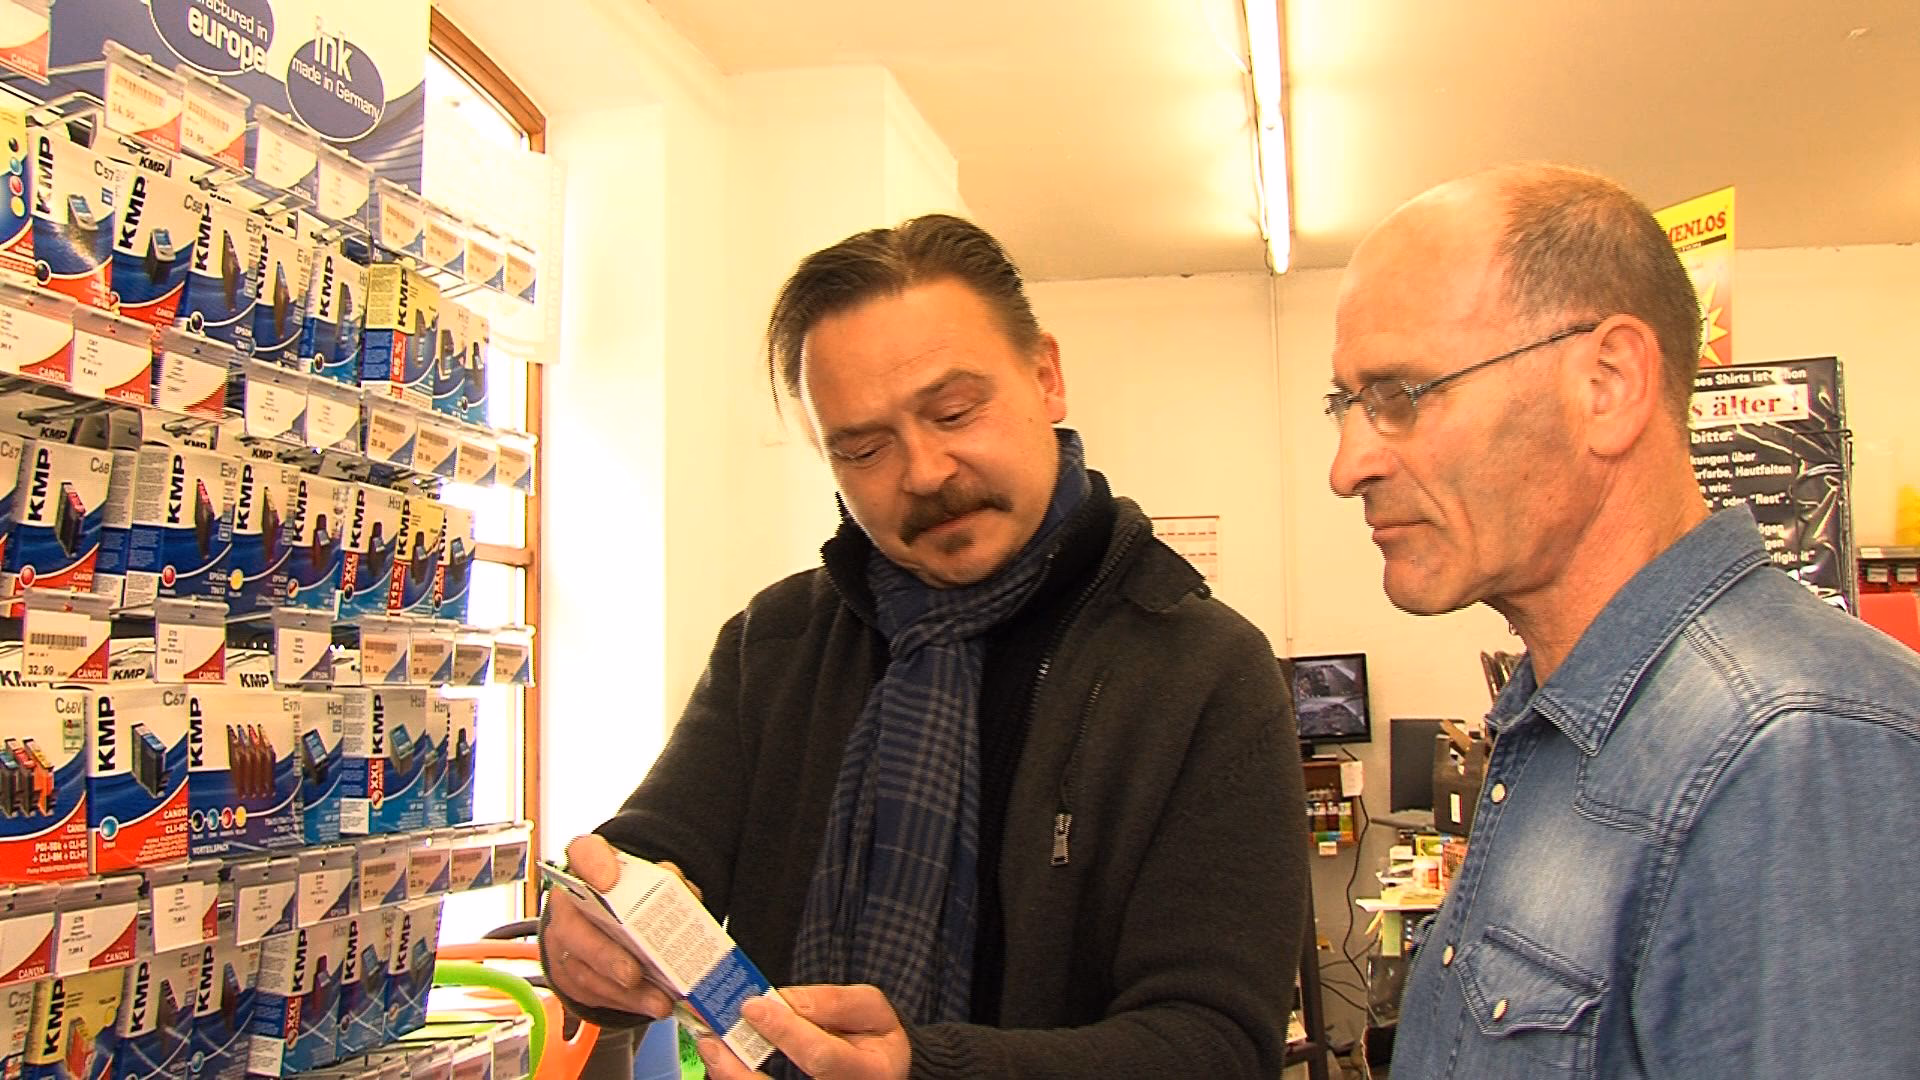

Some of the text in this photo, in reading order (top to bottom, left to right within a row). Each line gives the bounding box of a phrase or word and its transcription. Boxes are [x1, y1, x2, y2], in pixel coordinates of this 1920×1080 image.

[187, 6, 267, 73] europe
[196, 0, 268, 42] actured in
[314, 16, 352, 82] ink
[291, 56, 380, 125] made in Germany
[36, 136, 53, 214] KMP
[94, 160, 114, 180] C57
[139, 156, 166, 175] KMP
[118, 176, 146, 249] KMP
[184, 194, 202, 214] C58
[195, 203, 213, 271] KMP
[256, 234, 269, 299] KMP
[319, 256, 334, 317] KMP
[398, 268, 408, 327] KMP
[39, 367, 66, 381] CANON
[120, 390, 145, 403] CANON
[1715, 373, 1751, 386] Shirts
[40, 427, 68, 441] KMP
[1713, 395, 1781, 417] älter
[252, 447, 273, 460] KMP
[1735, 464, 1792, 478] Hautfalten
[28, 448, 51, 521] KMP
[168, 455, 185, 523] KMP
[236, 464, 254, 530] KMP
[293, 480, 309, 542] KMP
[350, 489, 365, 549] KMP
[397, 499, 410, 556] KMP
[208, 571, 227, 582] EPSON
[272, 573, 287, 583] EPSON
[343, 554, 355, 587] XXL
[77, 668, 103, 679] CANON
[112, 668, 145, 681] KMP
[163, 690, 186, 706] C67
[198, 671, 220, 680] CANON
[239, 673, 269, 688] KMP
[98, 696, 116, 771] KMP
[190, 697, 204, 767] KMP
[372, 694, 384, 754] KMP
[371, 761, 380, 790] XXL
[164, 809, 188, 819] CANON
[105, 951, 130, 964] CANON
[292, 928, 308, 992] KMP
[344, 920, 357, 980] KMP
[397, 914, 409, 970] KMP
[18, 965, 46, 980] CANON
[131, 961, 150, 1033] KMP
[198, 945, 214, 1012] KMP
[43, 978, 65, 1056] KMP
